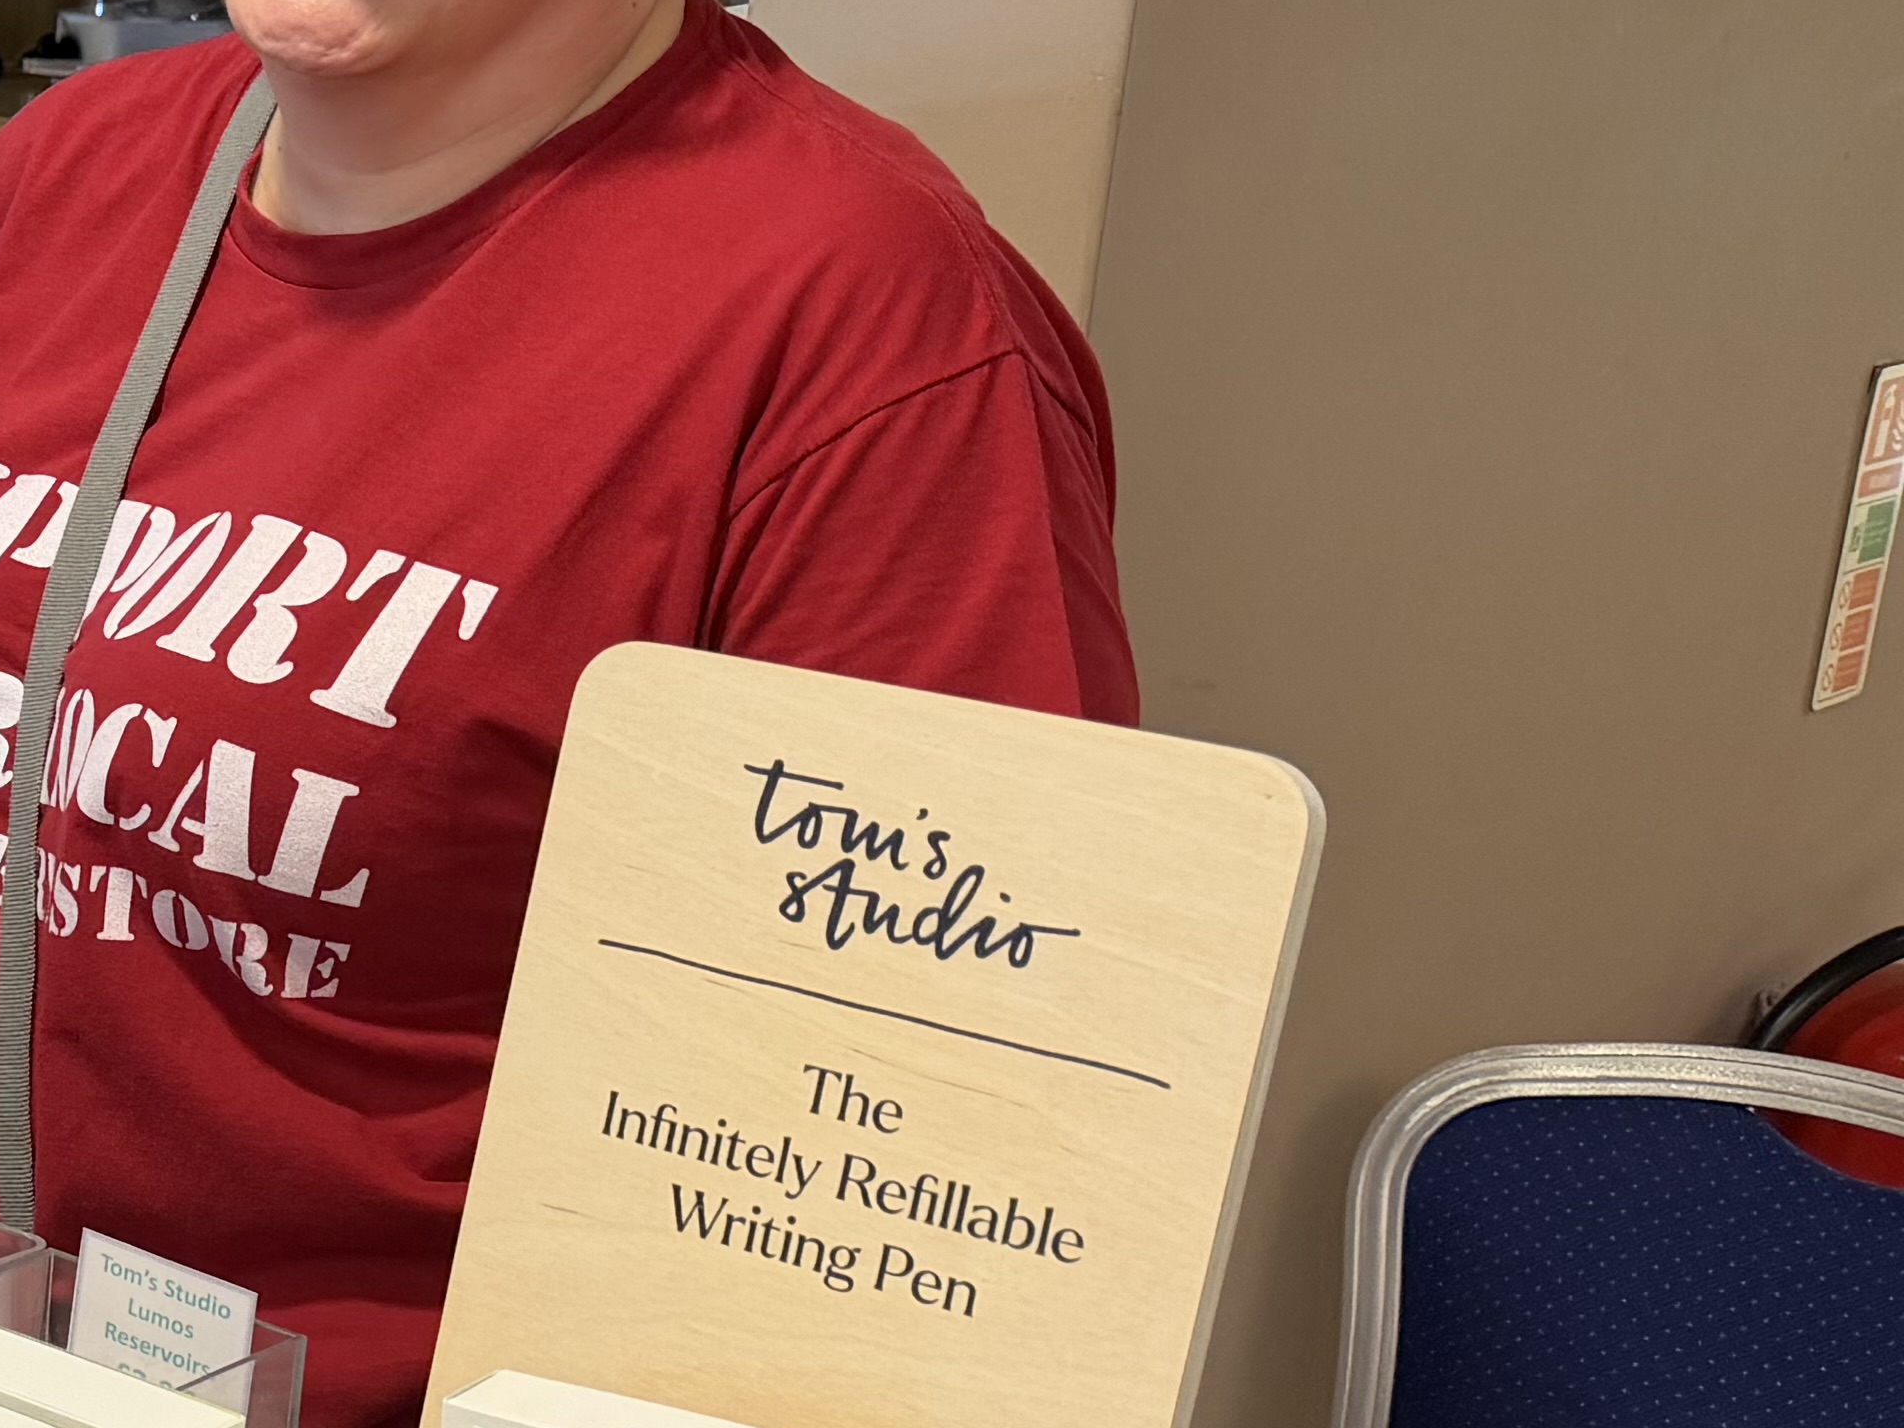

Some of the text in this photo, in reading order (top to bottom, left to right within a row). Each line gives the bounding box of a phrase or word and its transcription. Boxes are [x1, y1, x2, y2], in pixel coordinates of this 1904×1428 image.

[41, 686, 370, 908] OCAL
[744, 759, 951, 880] tom's
[778, 857, 1081, 968] studio
[803, 1064, 904, 1135] The
[602, 1091, 1086, 1265] Infinitely Refillable
[100, 1252, 232, 1321] Tom's Studio
[670, 1184, 979, 1319] Writing Pen
[104, 1321, 211, 1377] Reservoirs
[128, 1297, 195, 1340] Lumos
